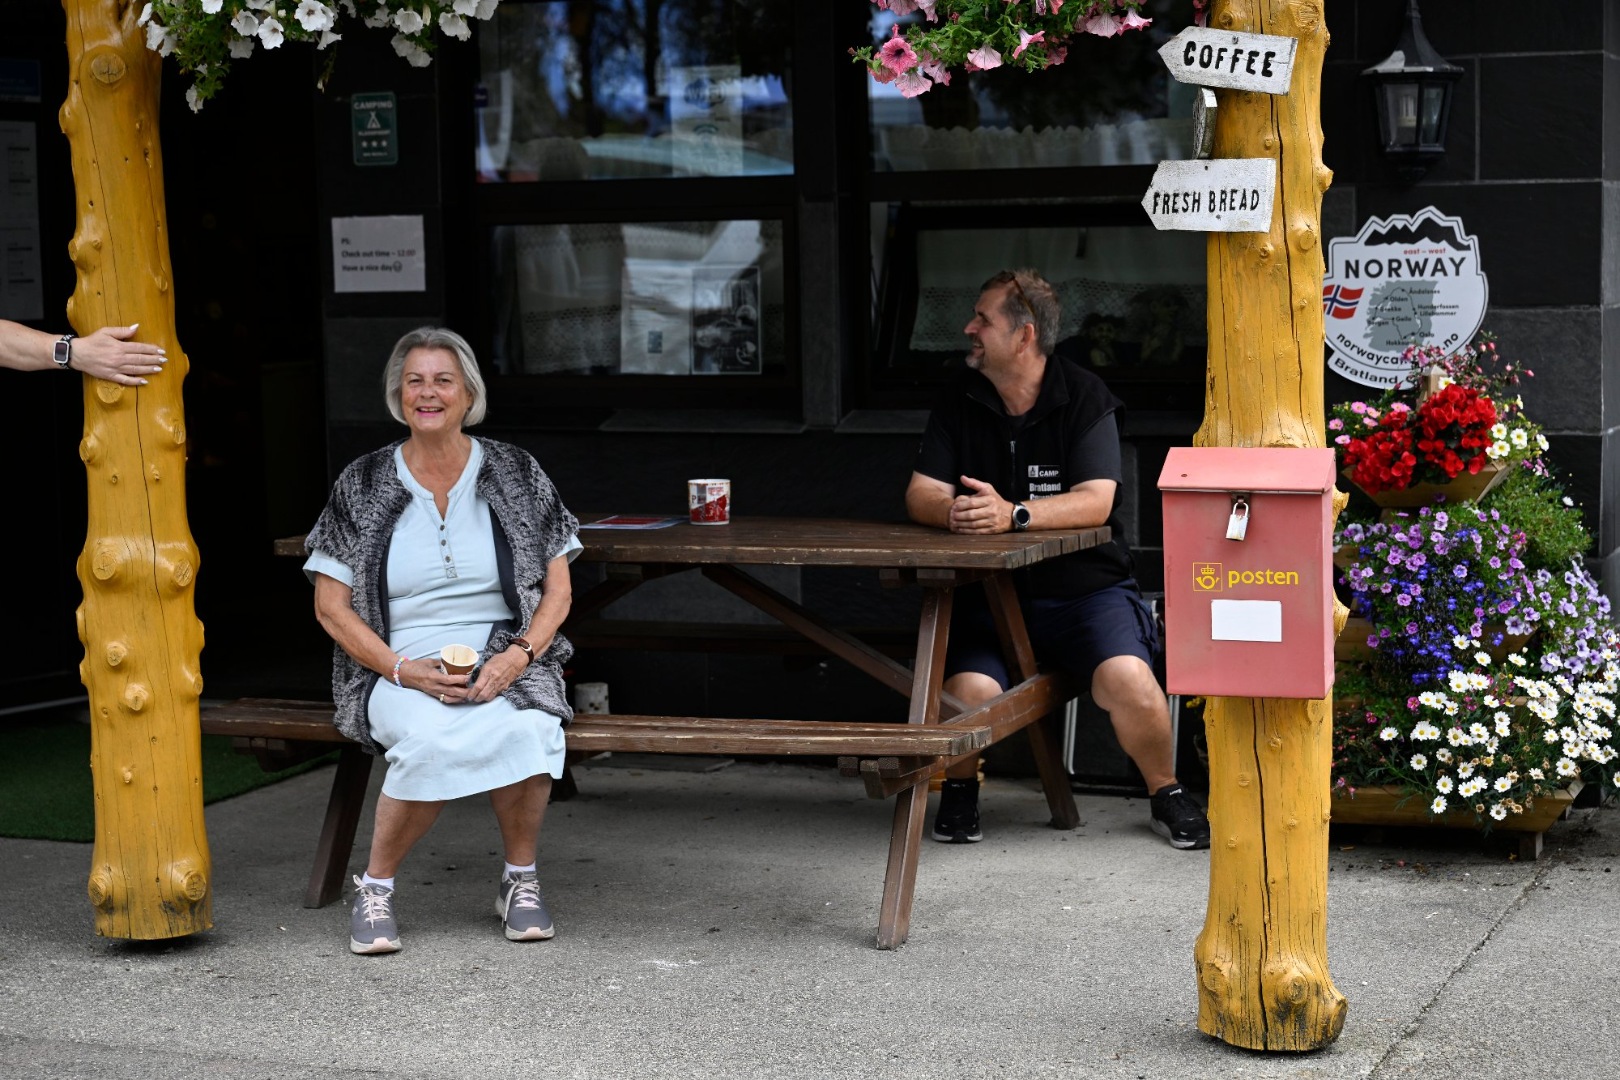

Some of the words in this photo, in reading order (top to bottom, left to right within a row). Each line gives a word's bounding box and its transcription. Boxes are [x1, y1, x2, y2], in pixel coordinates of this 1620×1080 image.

[1183, 40, 1276, 78] COFFEE
[353, 101, 393, 110] CAMPING
[1152, 191, 1201, 215] FRESH
[1208, 188, 1260, 212] BREAD
[341, 250, 361, 258] Check
[342, 264, 358, 272] Have
[381, 264, 393, 272] day
[1344, 257, 1466, 279] NORWAY
[1334, 358, 1398, 384] Bratland
[1029, 482, 1062, 492] Bratland
[1228, 568, 1299, 588] posten
